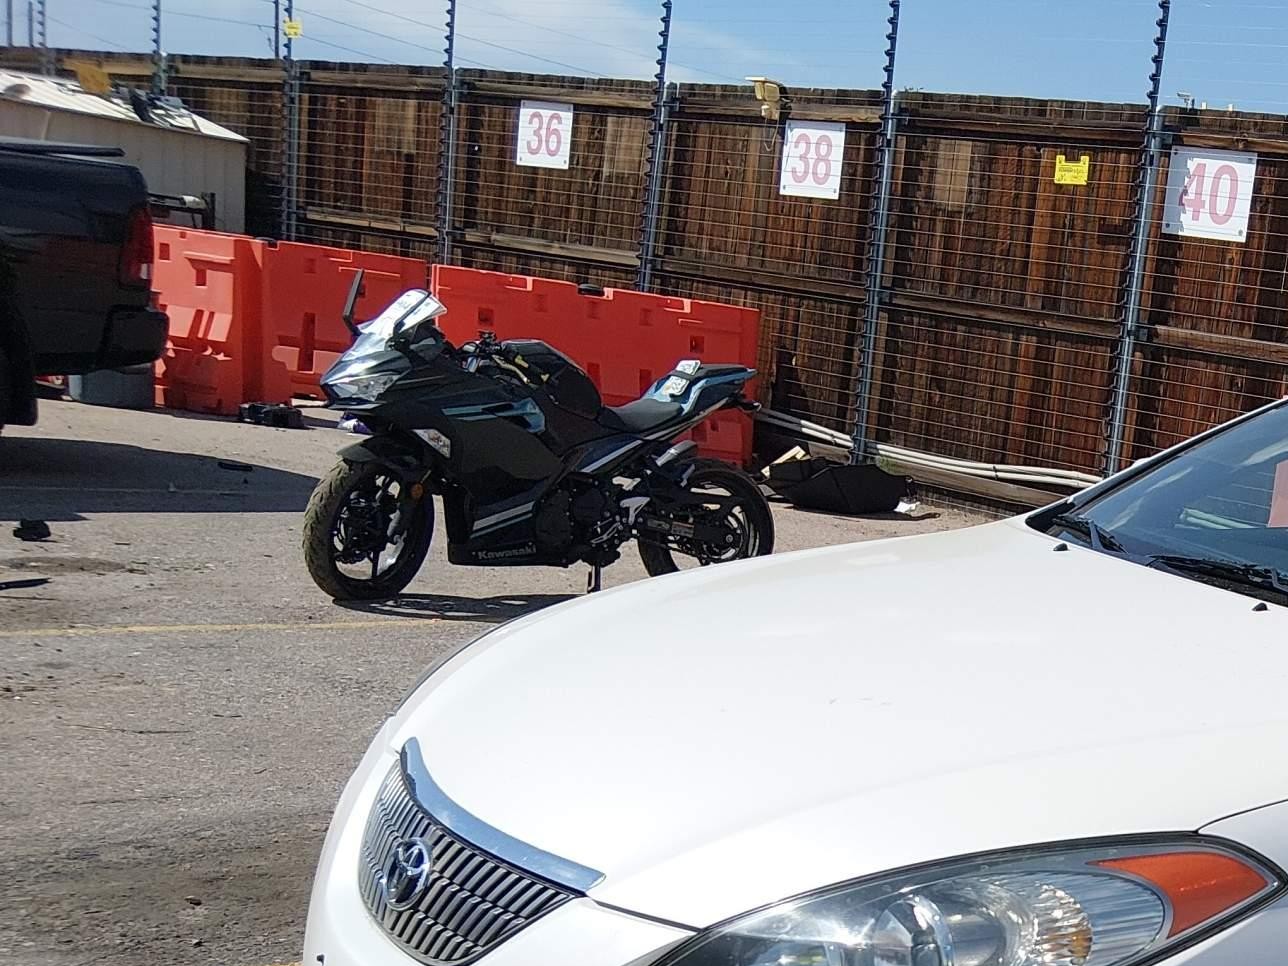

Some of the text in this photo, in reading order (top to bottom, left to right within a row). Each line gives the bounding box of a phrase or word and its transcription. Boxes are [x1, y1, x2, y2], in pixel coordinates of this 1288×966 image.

[526, 111, 563, 157] 36
[791, 133, 833, 186] 38
[1178, 162, 1239, 226] 40
[477, 542, 537, 560] Kawasaki
